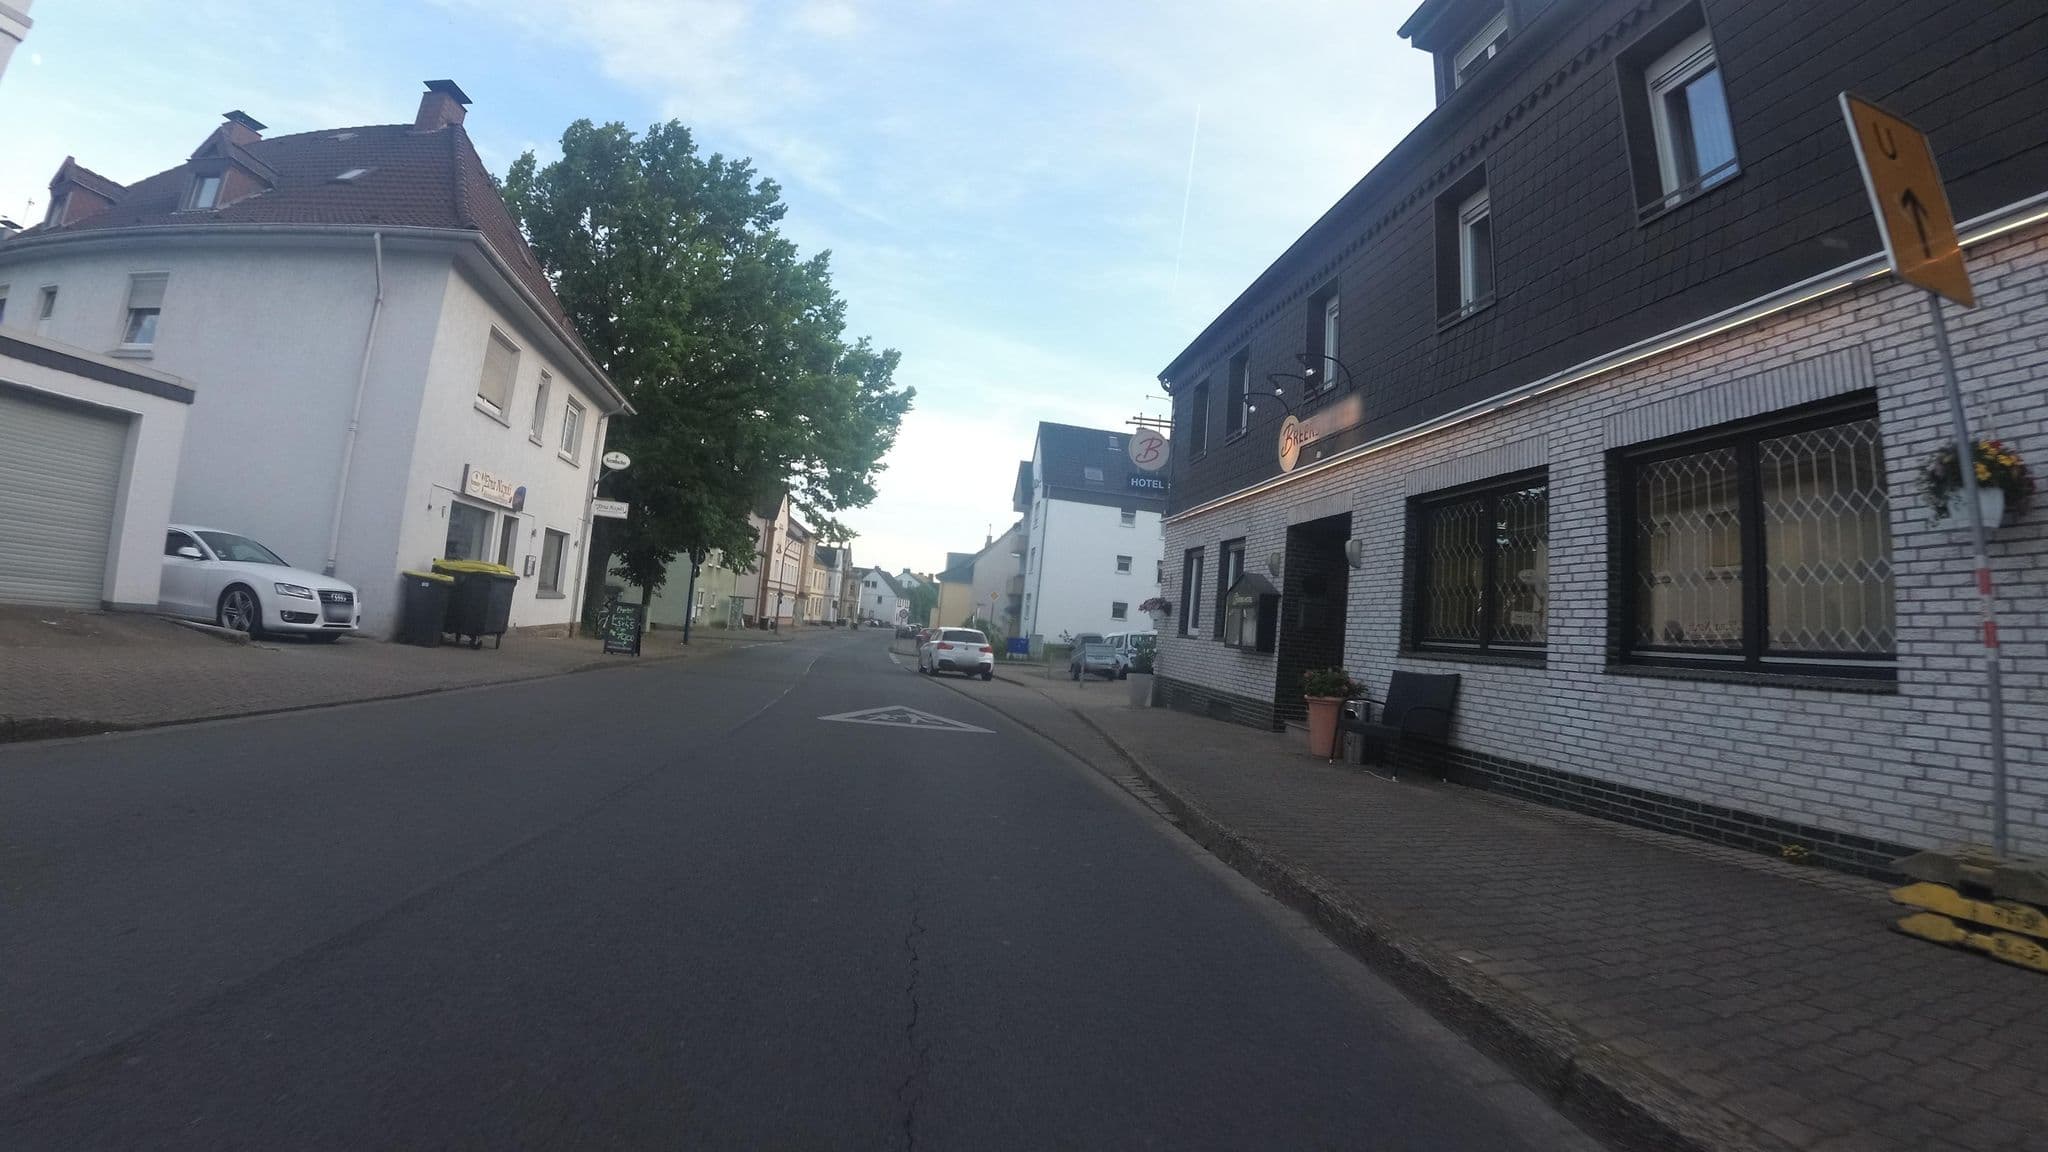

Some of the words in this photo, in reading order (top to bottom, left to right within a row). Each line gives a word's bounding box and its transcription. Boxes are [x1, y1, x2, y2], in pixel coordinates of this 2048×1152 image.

[1872, 121, 1897, 160] U
[1135, 437, 1164, 463] B
[1131, 478, 1164, 489] HOTEL
